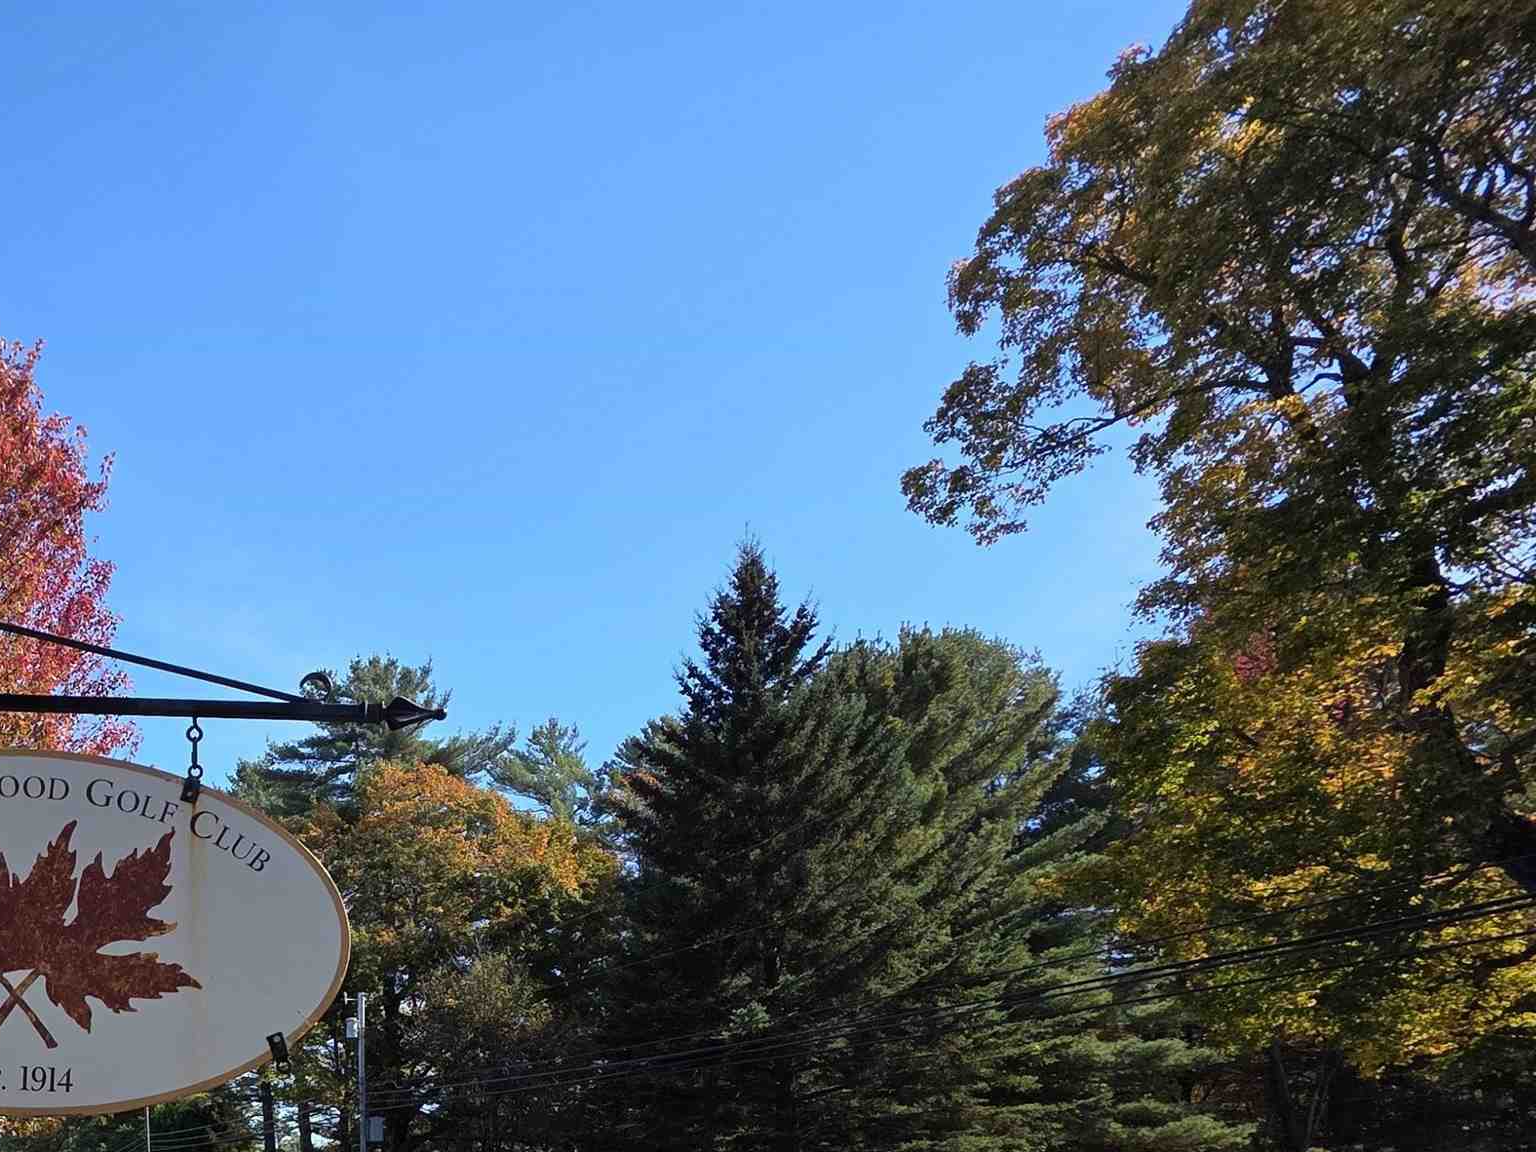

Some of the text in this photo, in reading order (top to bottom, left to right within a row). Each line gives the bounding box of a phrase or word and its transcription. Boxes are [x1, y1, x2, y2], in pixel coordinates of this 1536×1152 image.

[85, 778, 180, 824] GOLF
[189, 809, 272, 873] CLUB
[19, 1065, 74, 1093] 1914
